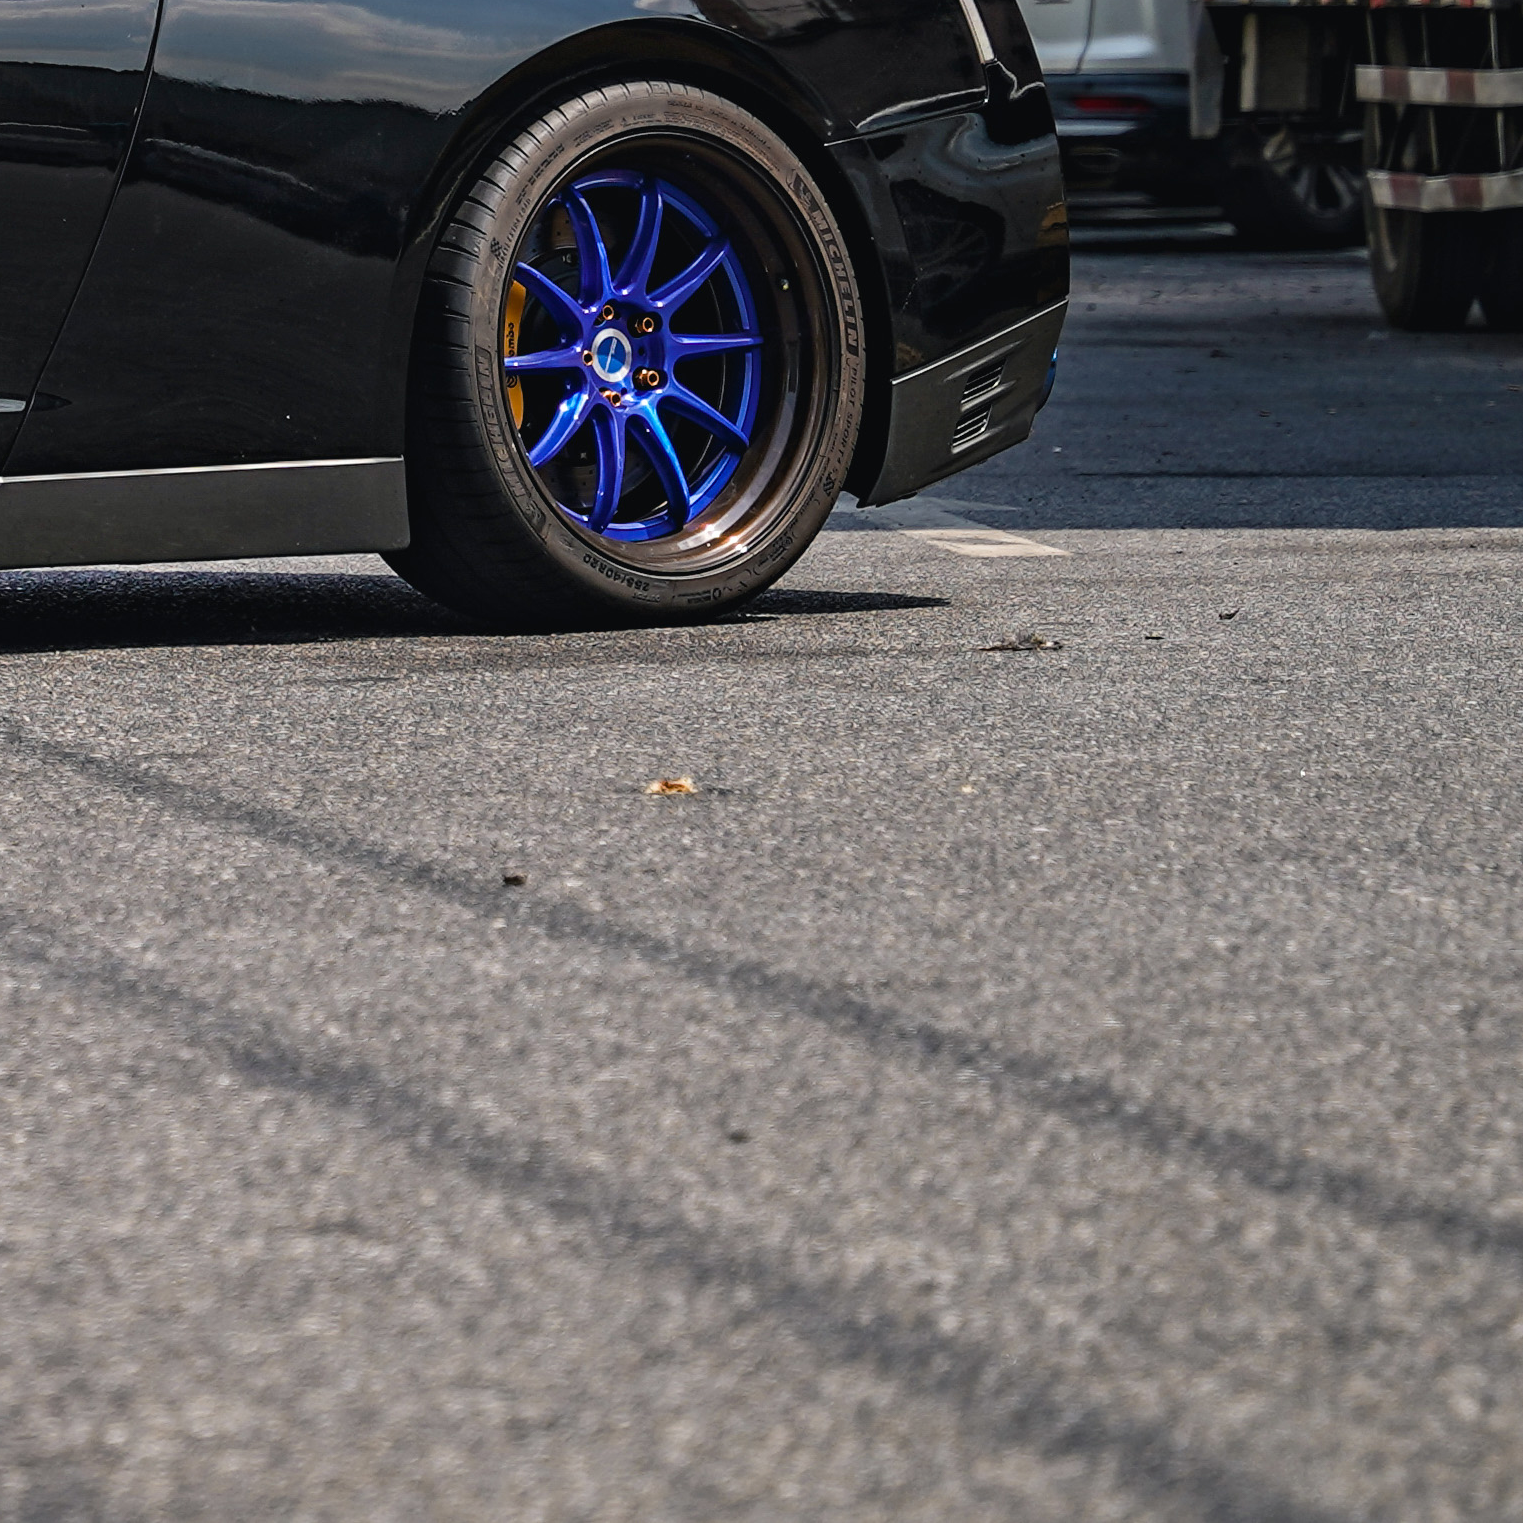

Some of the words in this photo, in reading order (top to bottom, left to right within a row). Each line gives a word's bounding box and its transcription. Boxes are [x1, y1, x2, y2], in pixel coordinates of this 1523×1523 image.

[810, 209, 858, 343] MICHELIN
[477, 355, 526, 499] MICHELIN
[848, 367, 858, 407] PILOT
[838, 412, 853, 456] SPORT
